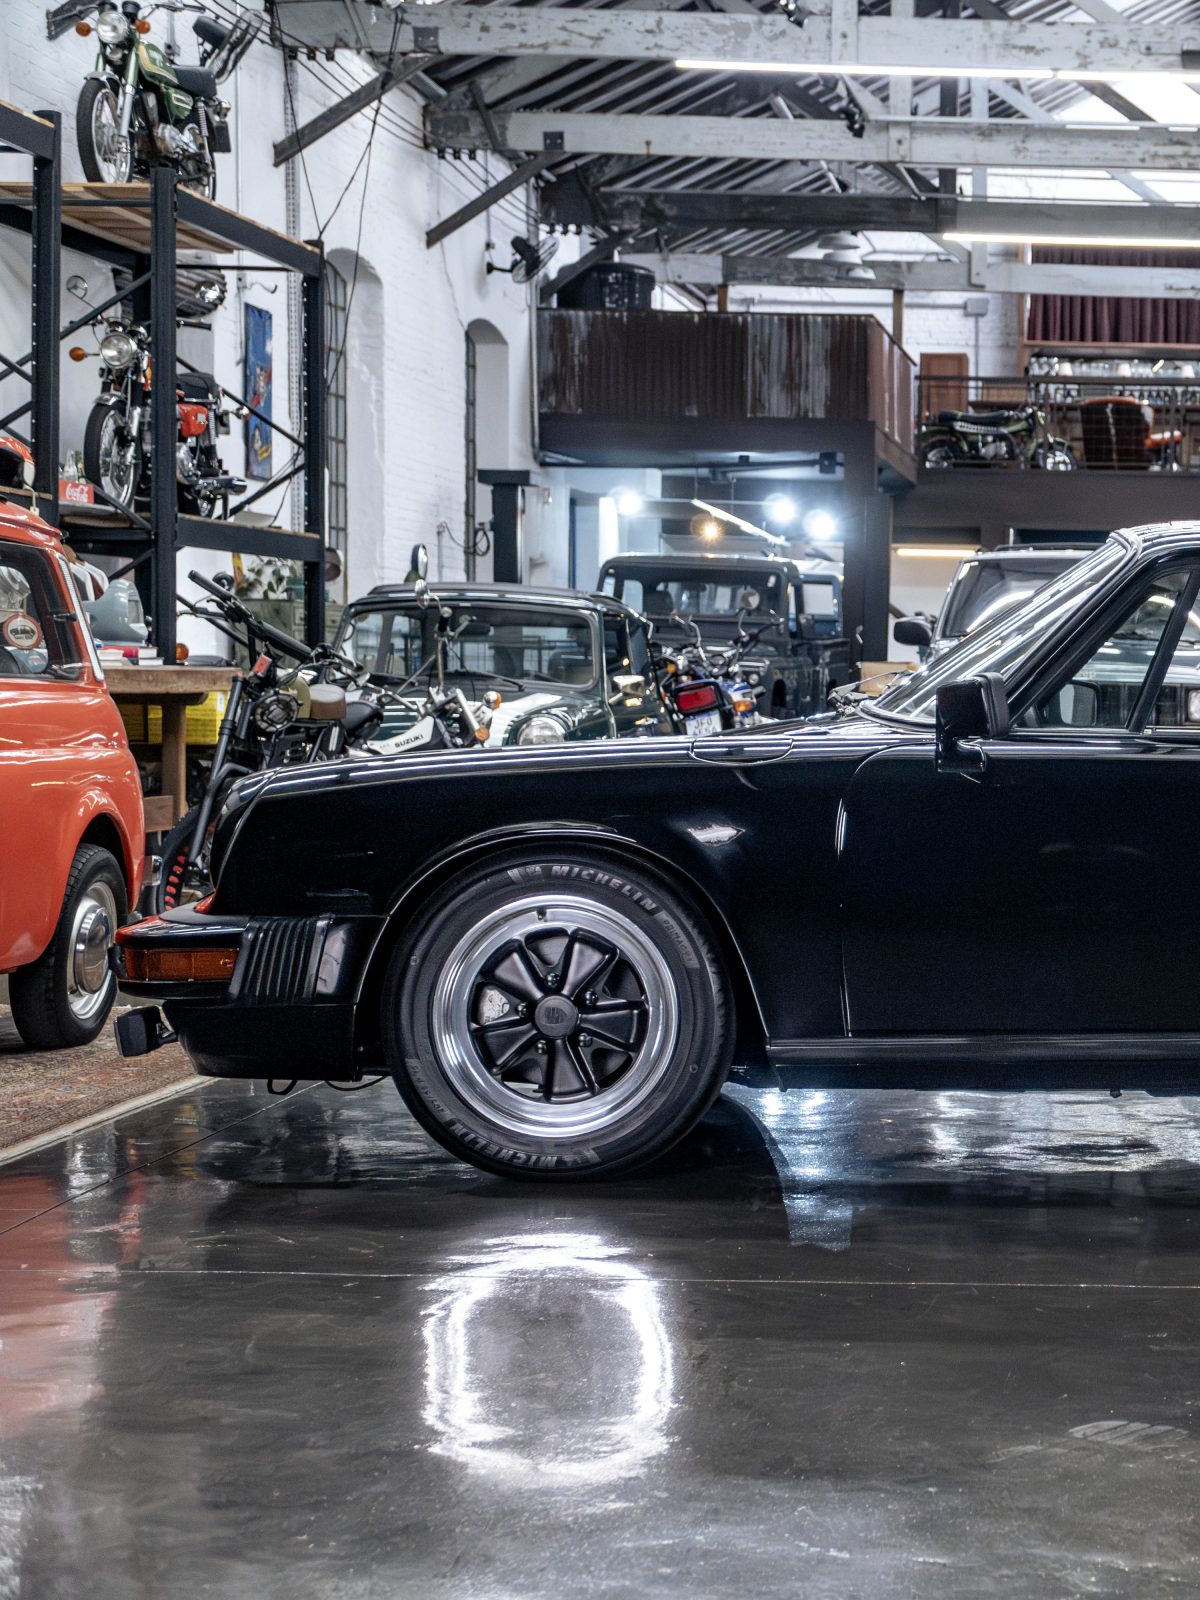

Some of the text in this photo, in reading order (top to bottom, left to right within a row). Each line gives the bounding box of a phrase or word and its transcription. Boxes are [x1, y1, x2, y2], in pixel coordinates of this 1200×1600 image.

[394, 734, 424, 748] SUZUKI
[551, 865, 657, 911] MICHELIN
[451, 1122, 558, 1168] MICHELIN
